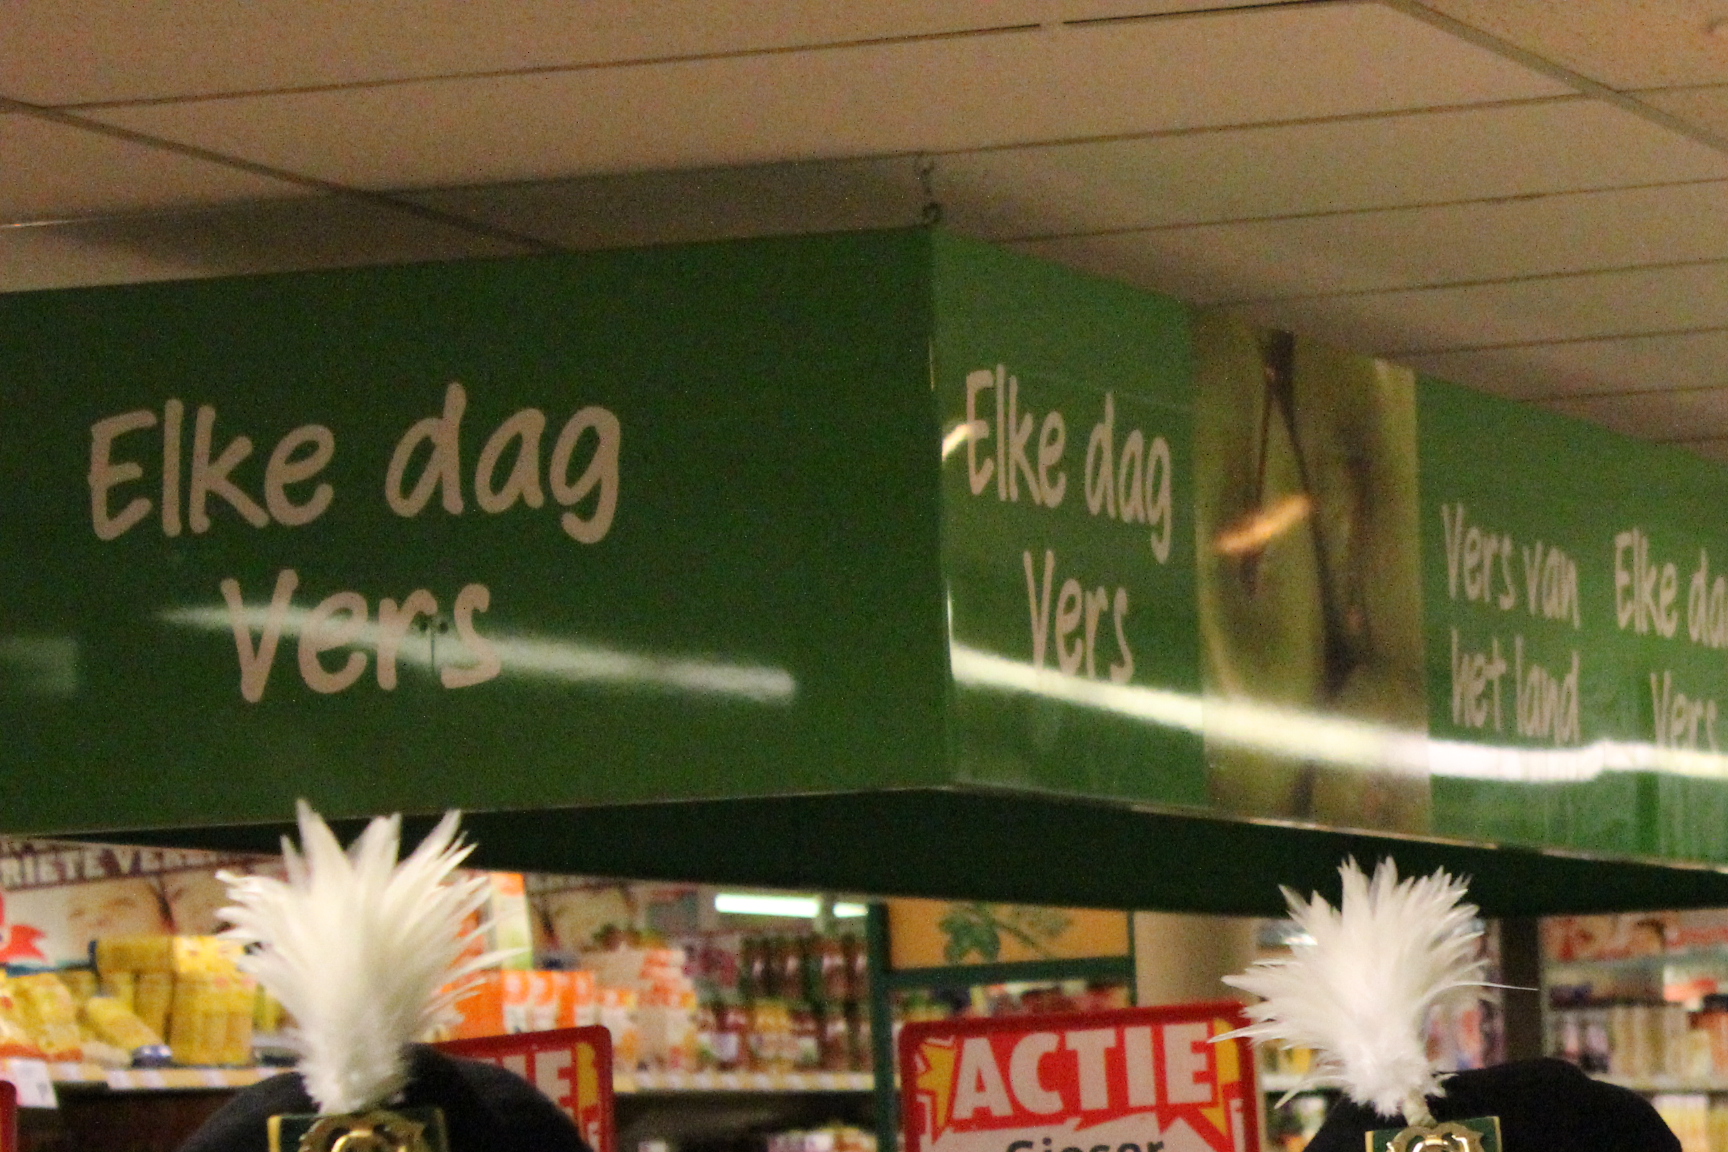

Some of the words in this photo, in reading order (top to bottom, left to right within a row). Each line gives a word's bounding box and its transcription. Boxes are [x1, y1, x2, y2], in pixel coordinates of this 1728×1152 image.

[87, 398, 335, 541] Elke
[384, 381, 622, 545] dag
[964, 364, 1067, 507] Elke
[1083, 391, 1173, 563] dag
[1023, 550, 1135, 685] Vers
[1441, 503, 1518, 608] Vers
[1521, 541, 1581, 628] van
[1614, 527, 1679, 638] Elke
[220, 567, 503, 704] Vers
[1449, 628, 1508, 733] het
[1515, 637, 1581, 743] land
[952, 1022, 1216, 1121] ACTIE
